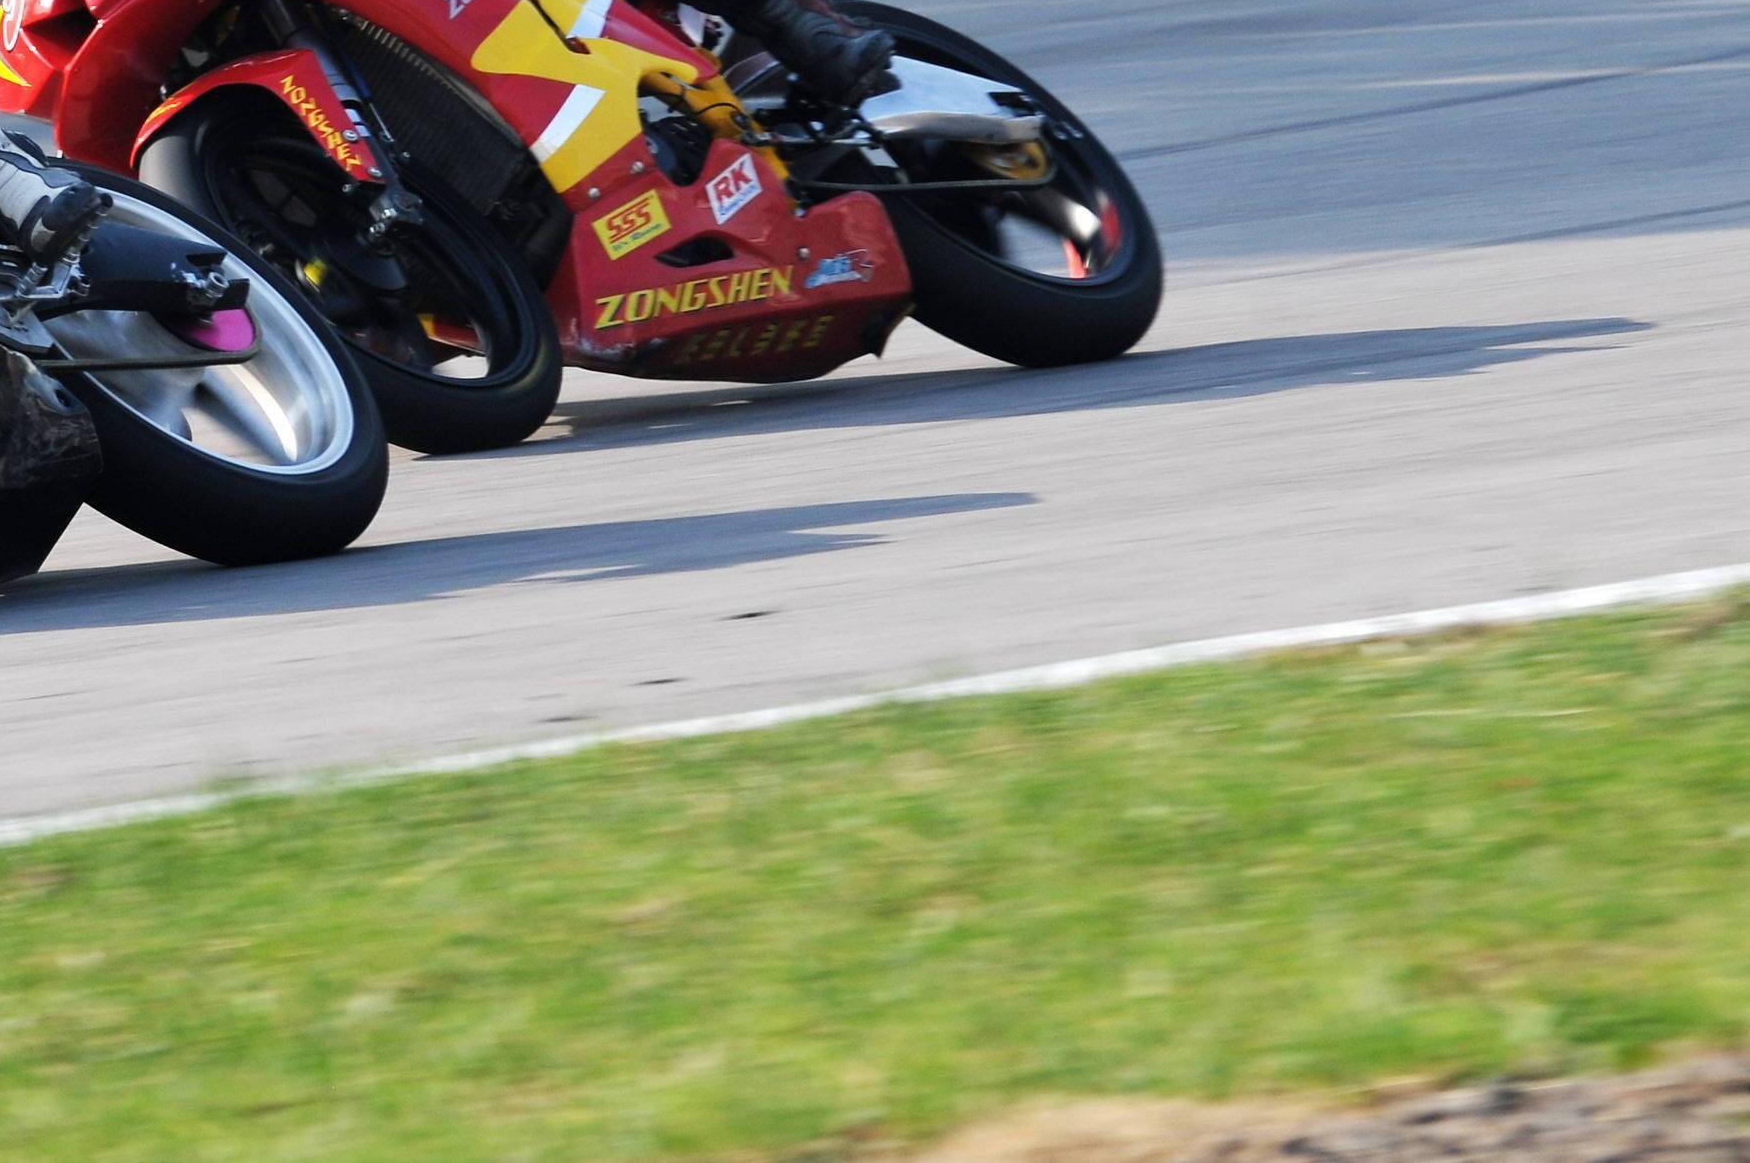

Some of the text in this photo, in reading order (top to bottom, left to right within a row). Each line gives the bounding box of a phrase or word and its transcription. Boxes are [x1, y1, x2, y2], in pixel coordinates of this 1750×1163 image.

[280, 74, 362, 172] ZONGSHEN
[713, 160, 753, 206] RK
[606, 197, 653, 244] SSS
[594, 264, 794, 329] ZONGSHEN
